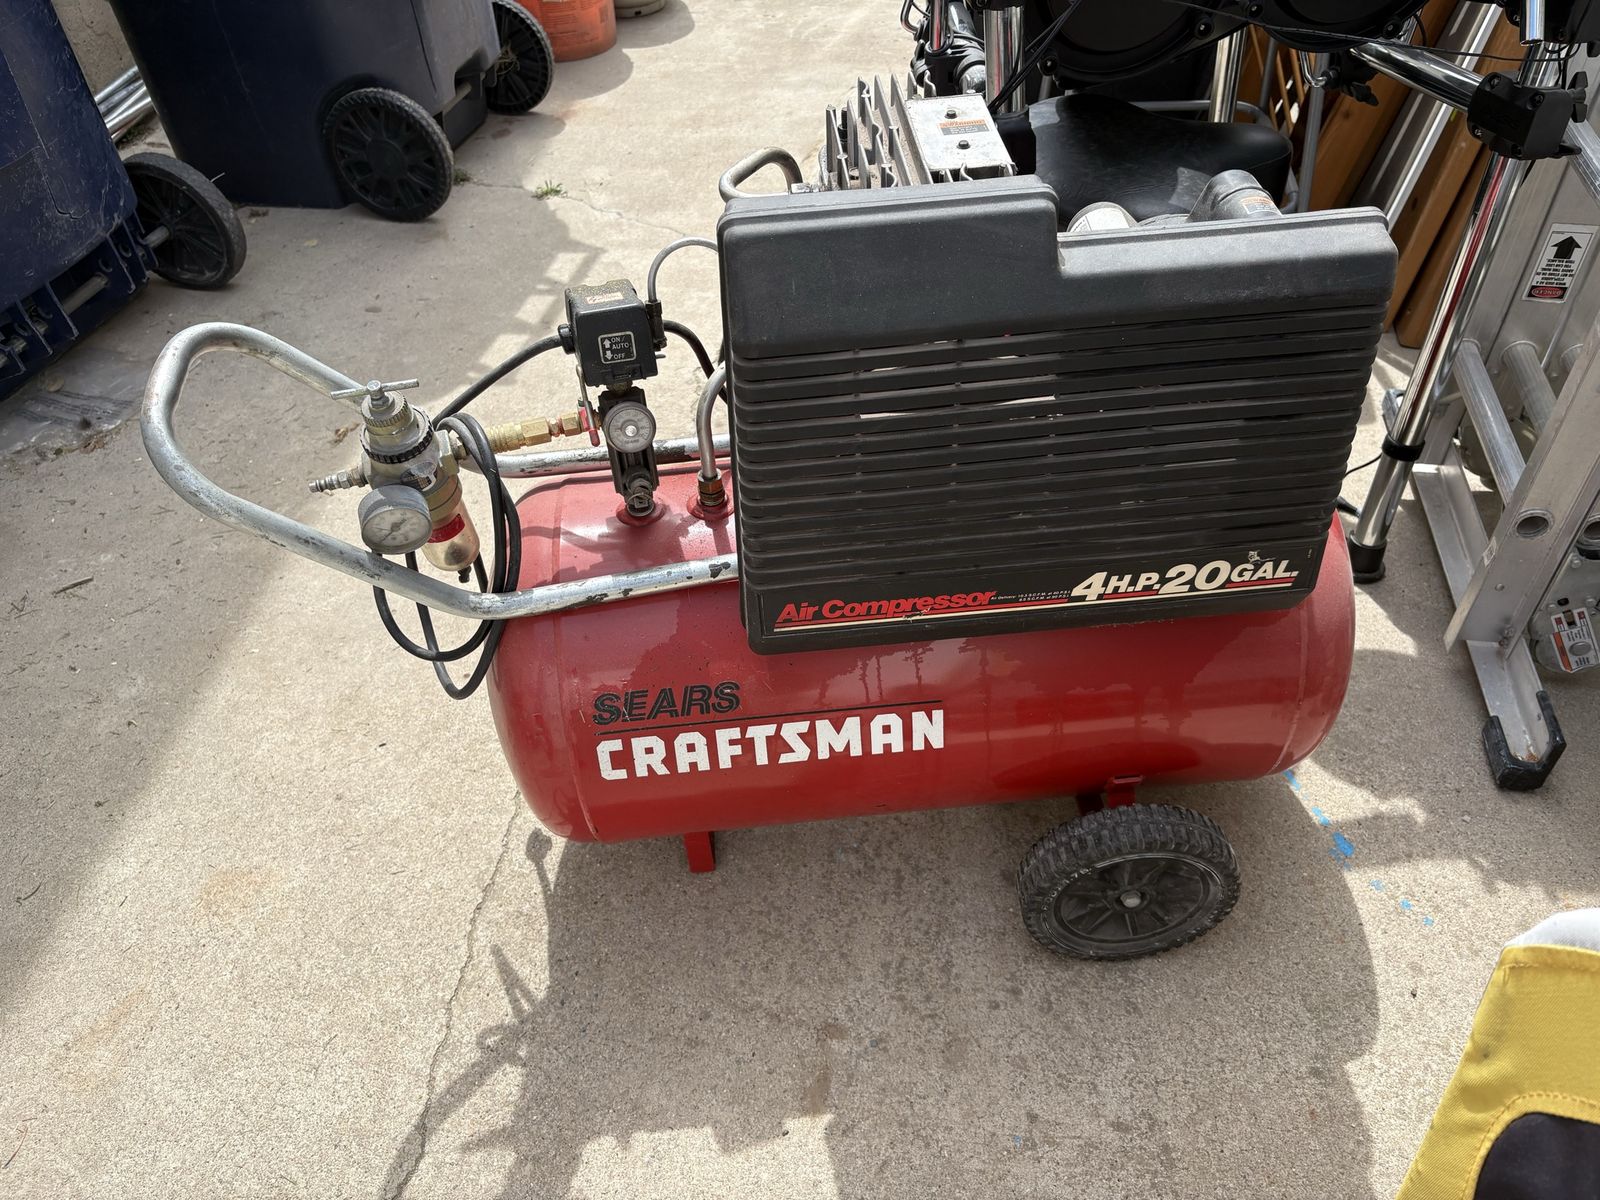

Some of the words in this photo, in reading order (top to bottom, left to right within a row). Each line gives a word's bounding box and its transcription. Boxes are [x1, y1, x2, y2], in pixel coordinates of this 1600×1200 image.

[1071, 571, 1108, 601] 4
[1104, 572, 1161, 594] H.P.
[1158, 560, 1232, 595] 20
[1230, 560, 1299, 583] GAL.
[776, 602, 819, 623] Air
[822, 591, 997, 618] Compressor
[592, 681, 740, 726] SEARS
[596, 709, 944, 781] CRAFTSMAN
